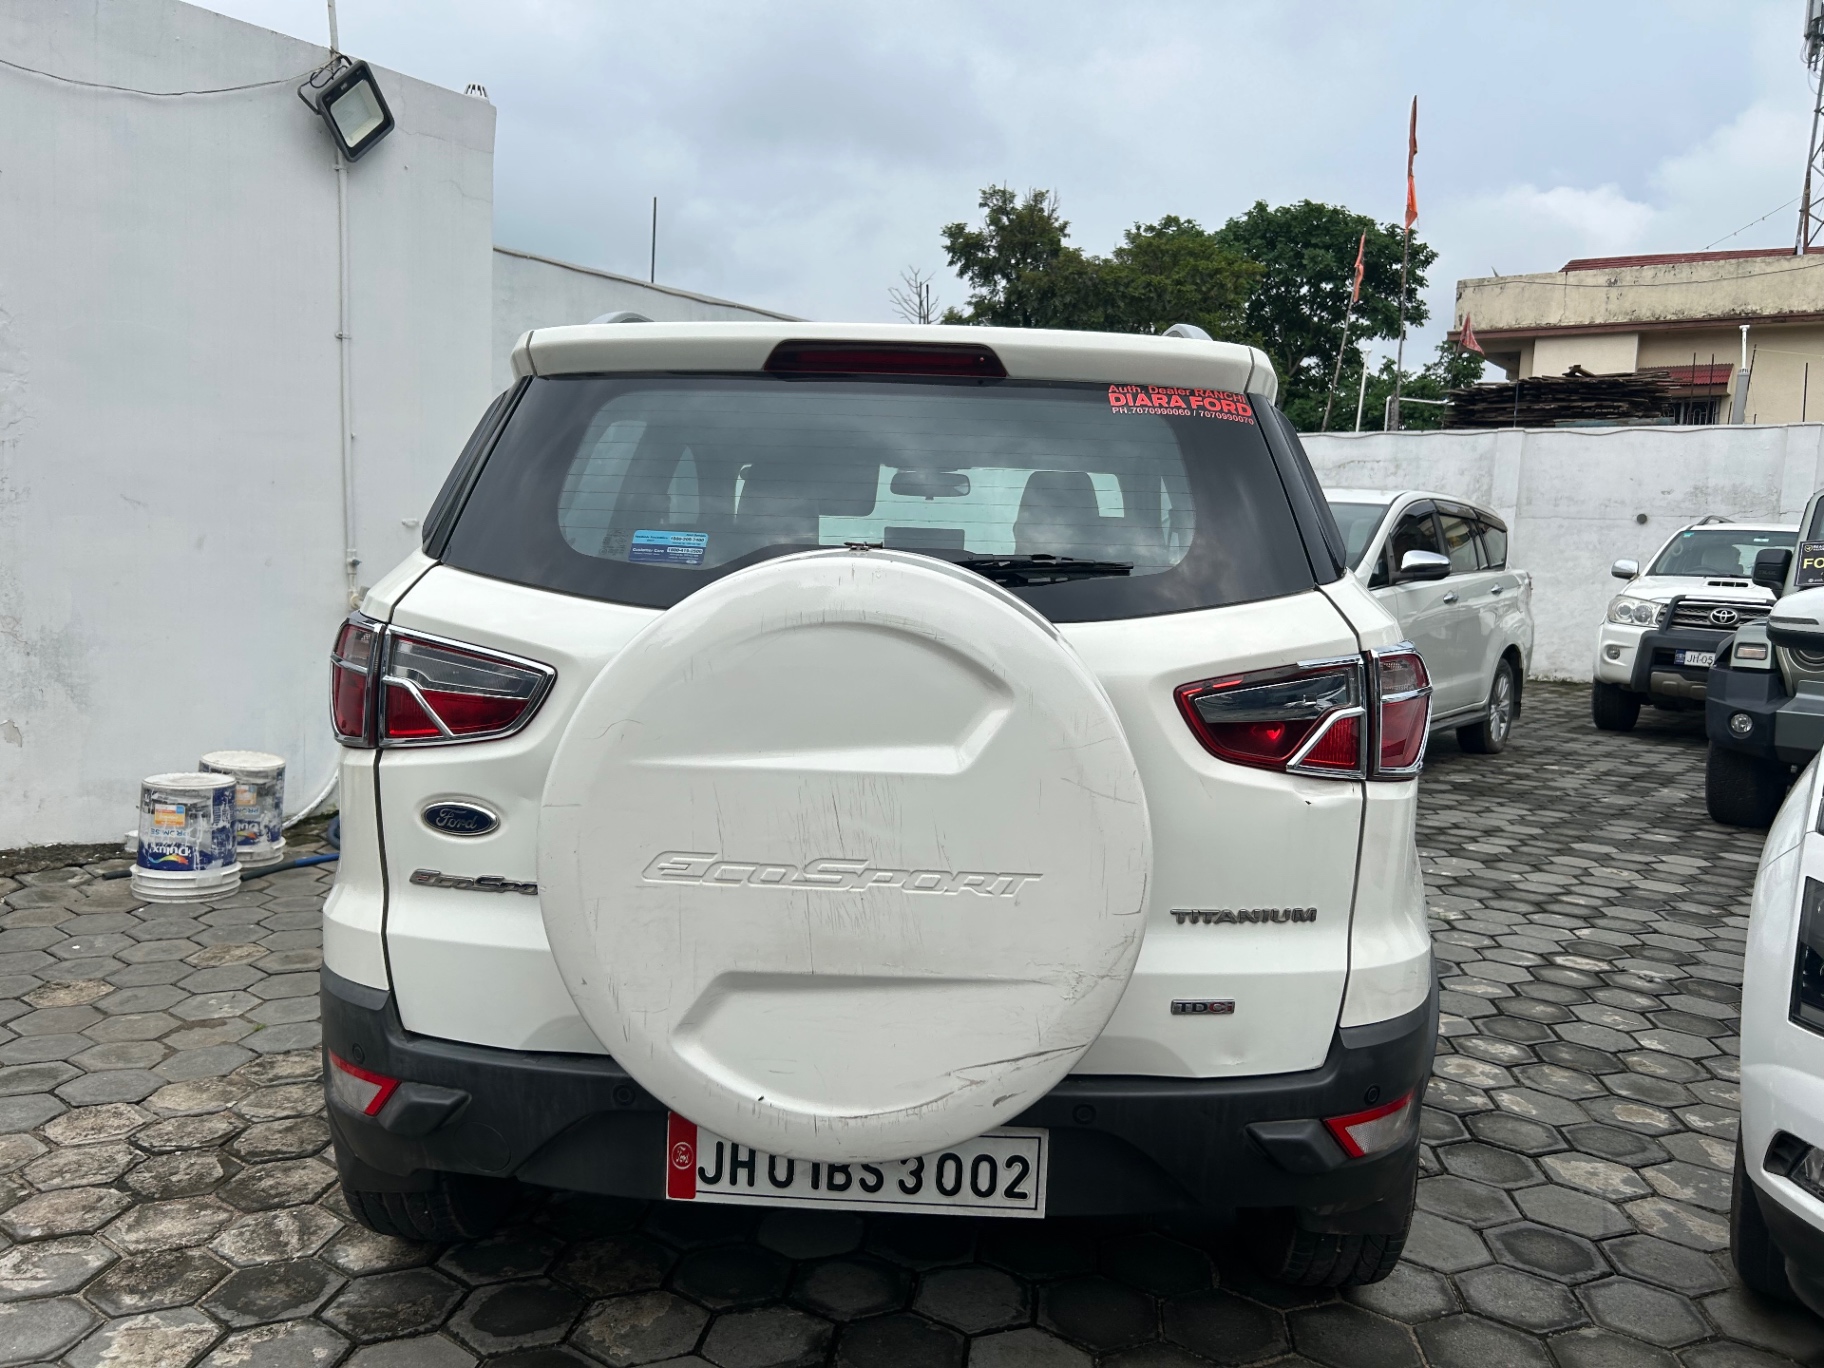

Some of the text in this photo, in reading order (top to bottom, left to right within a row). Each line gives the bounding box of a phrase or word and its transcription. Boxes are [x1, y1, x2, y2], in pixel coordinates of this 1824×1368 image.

[1109, 385, 1246, 403] Auth. Dealer RANCHI
[1109, 393, 1252, 417] DIARA FORD
[436, 808, 478, 829] Ford
[152, 846, 189, 856] Dulux
[1170, 908, 1318, 925] TITANIUM
[1175, 1001, 1234, 1014] TDCi
